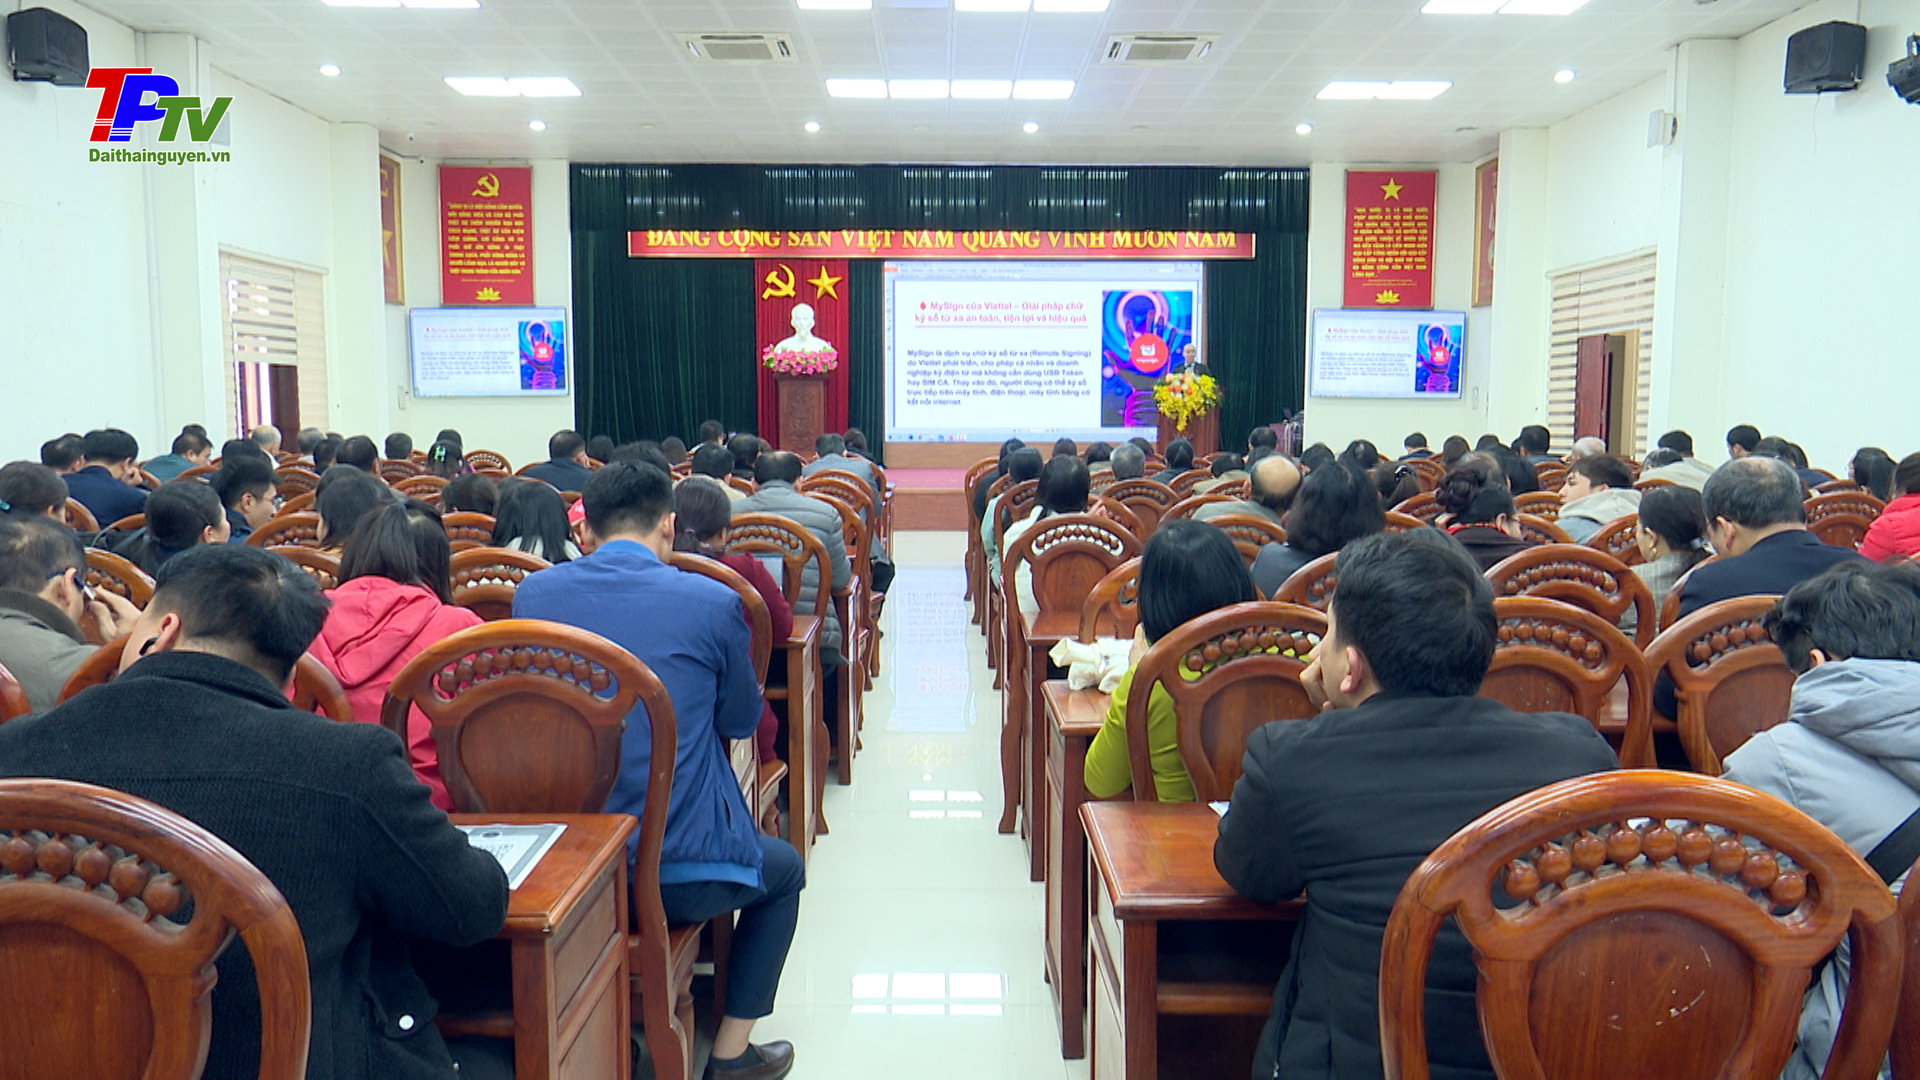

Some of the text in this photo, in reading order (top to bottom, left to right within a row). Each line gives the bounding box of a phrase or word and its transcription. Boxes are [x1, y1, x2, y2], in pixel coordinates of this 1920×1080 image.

[901, 230, 955, 248] NAM
[961, 230, 1041, 252] QUANG
[1048, 230, 1106, 248] VINH
[930, 302, 964, 312] MySign
[966, 302, 982, 310] của
[984, 302, 1012, 310] Viettel
[1041, 302, 1064, 311] pháp
[1036, 314, 1047, 322] và
[907, 349, 934, 357] MySign
